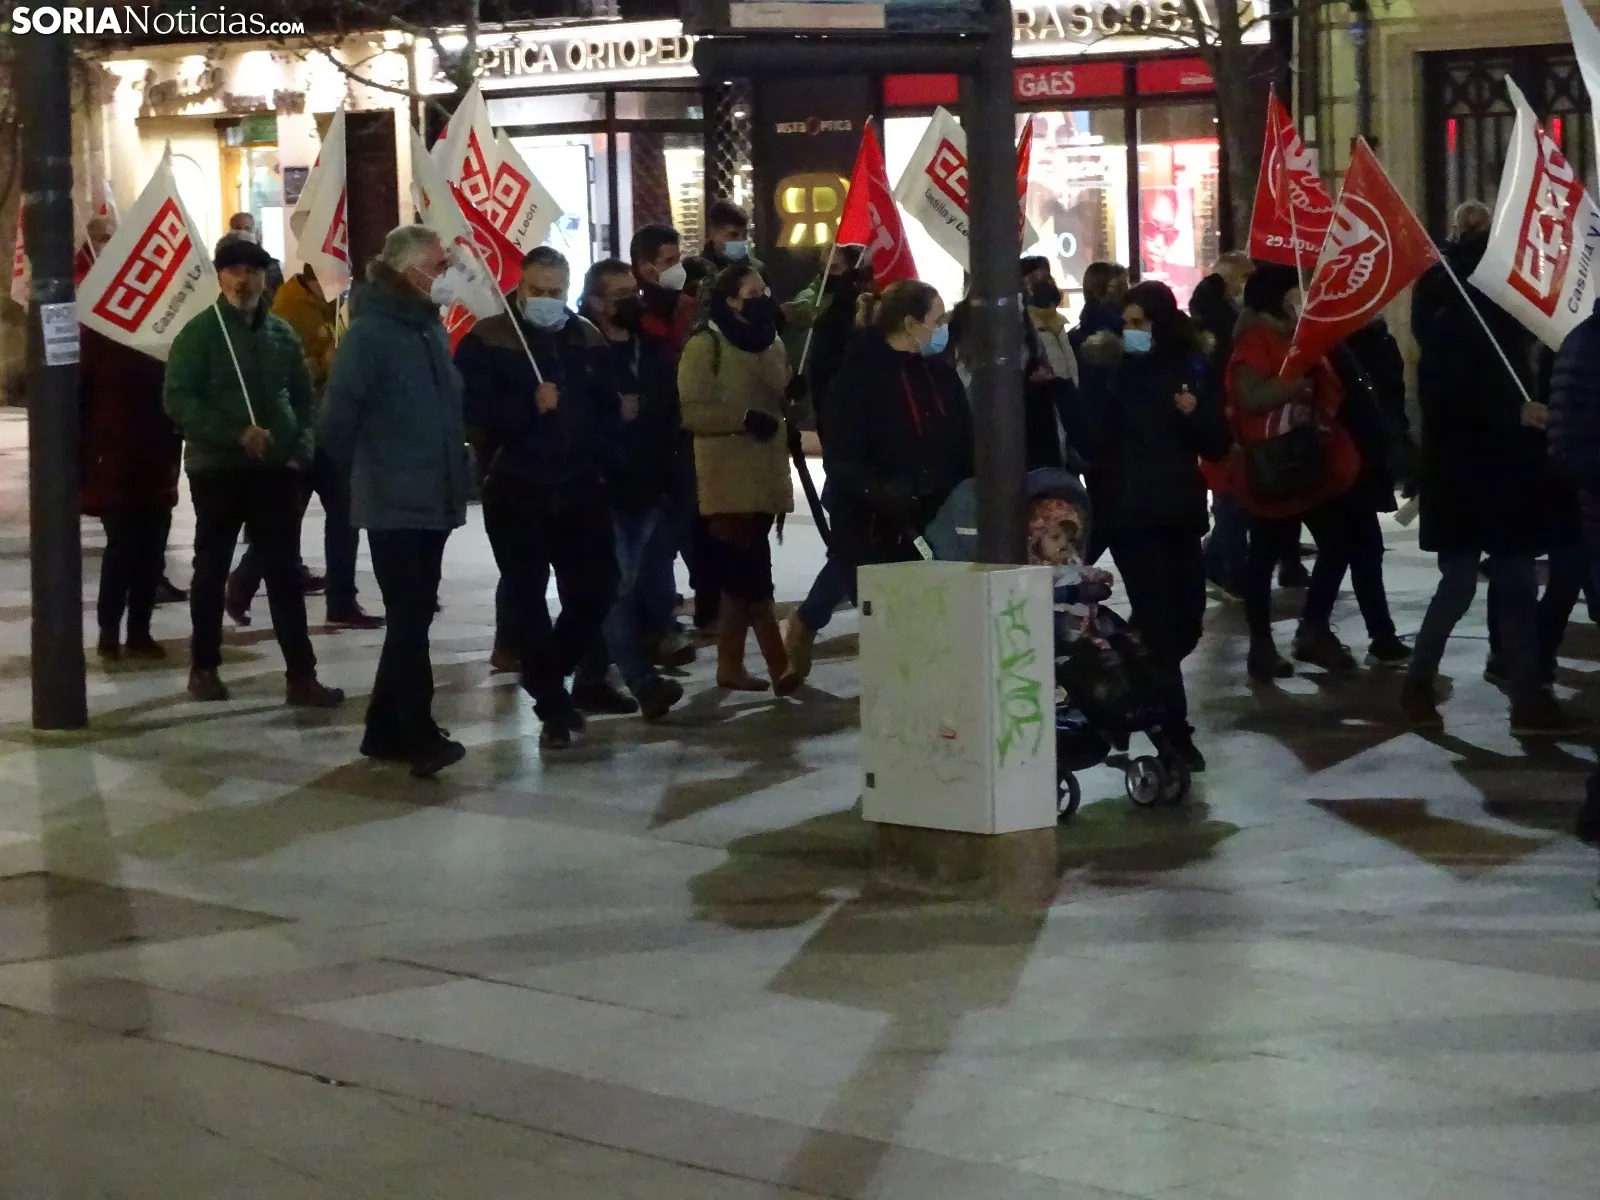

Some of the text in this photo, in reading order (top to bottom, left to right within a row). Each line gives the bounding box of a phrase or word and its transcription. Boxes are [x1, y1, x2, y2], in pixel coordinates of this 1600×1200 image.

[474, 42, 558, 76] PTICA
[1018, 71, 1076, 97] GAES
[519, 202, 539, 236] León
[104, 210, 189, 322] CCOO
[1567, 243, 1596, 316] Castilla
